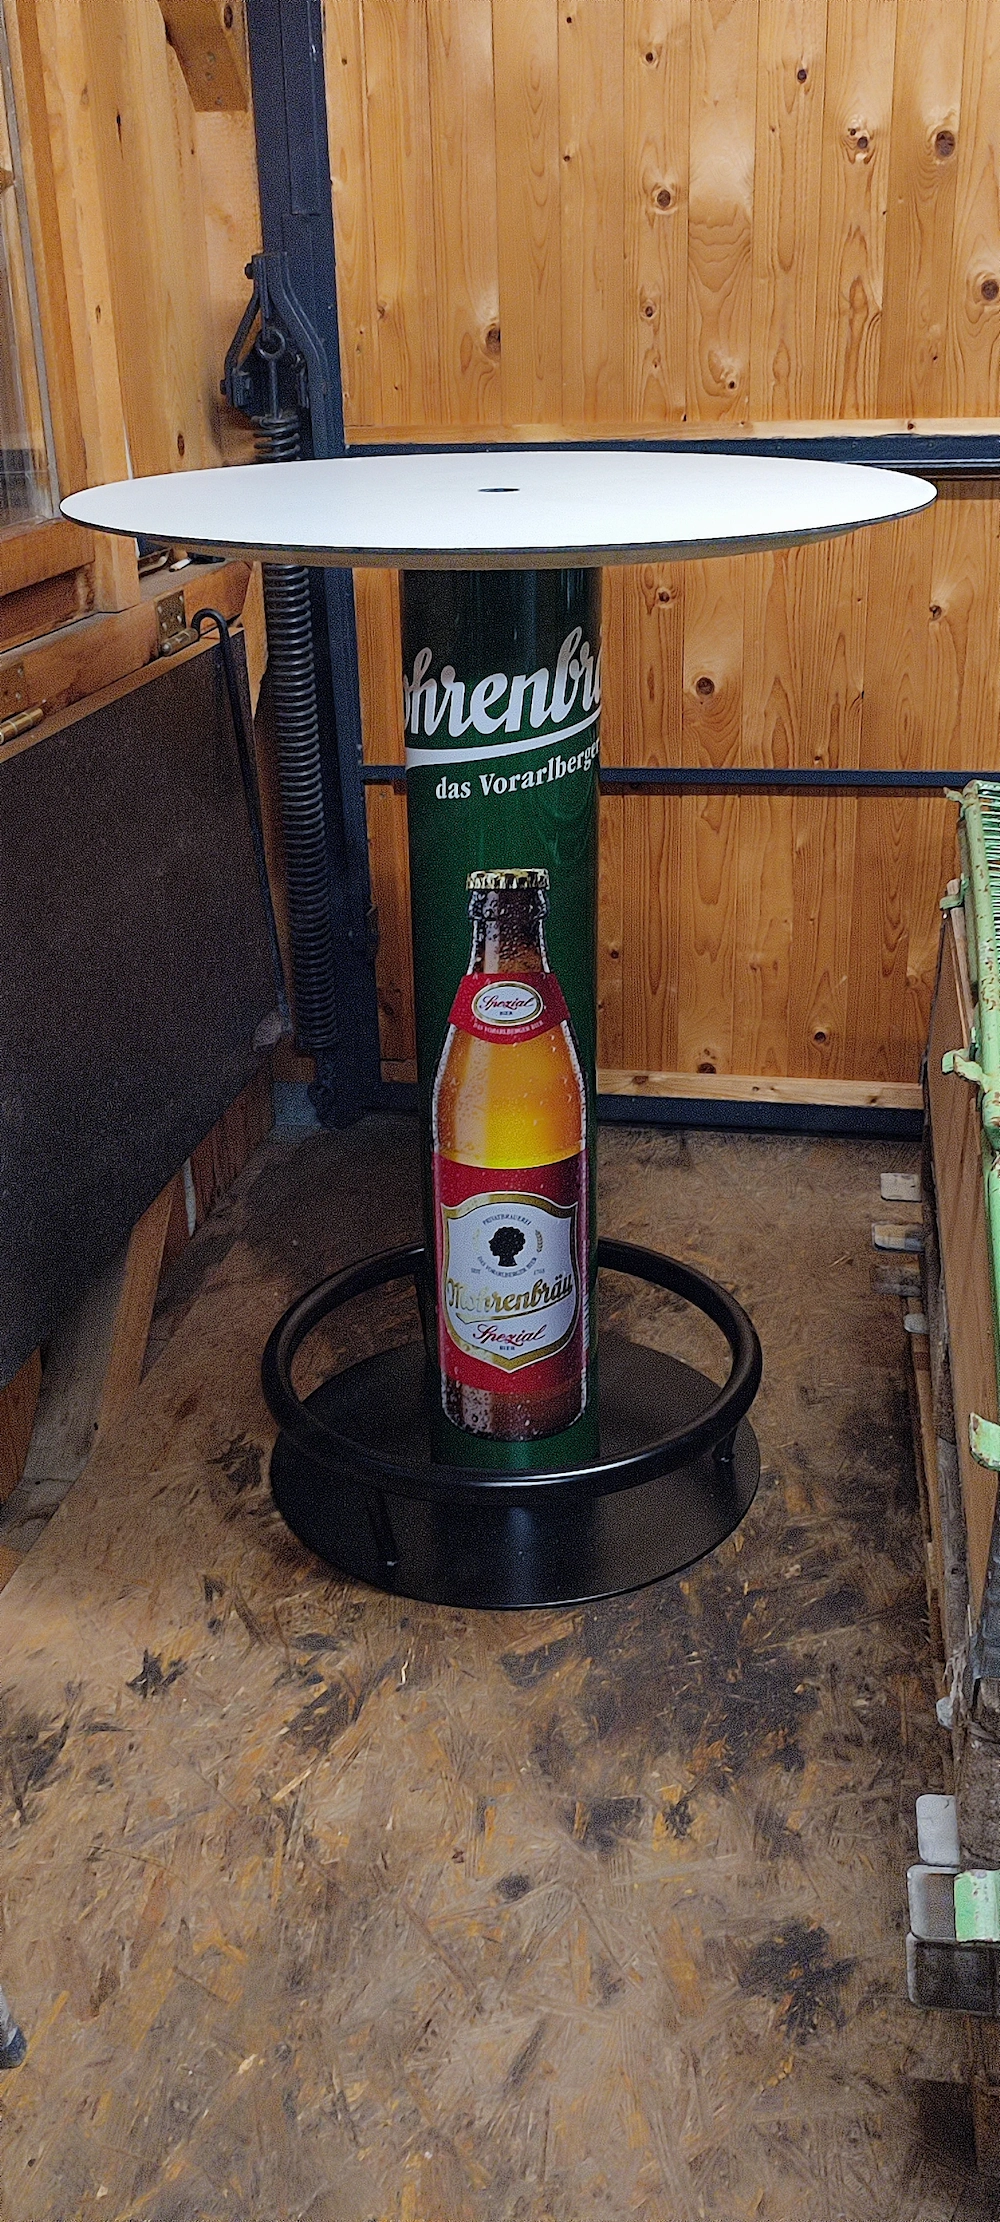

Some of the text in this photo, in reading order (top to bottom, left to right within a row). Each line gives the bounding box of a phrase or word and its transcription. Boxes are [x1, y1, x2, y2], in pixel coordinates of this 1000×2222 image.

[435, 737, 600, 800] das Vorarlberger
[479, 995, 534, 1011] Spezial
[447, 1274, 573, 1313] Mohrenbräu
[472, 1324, 547, 1347] Spezial
